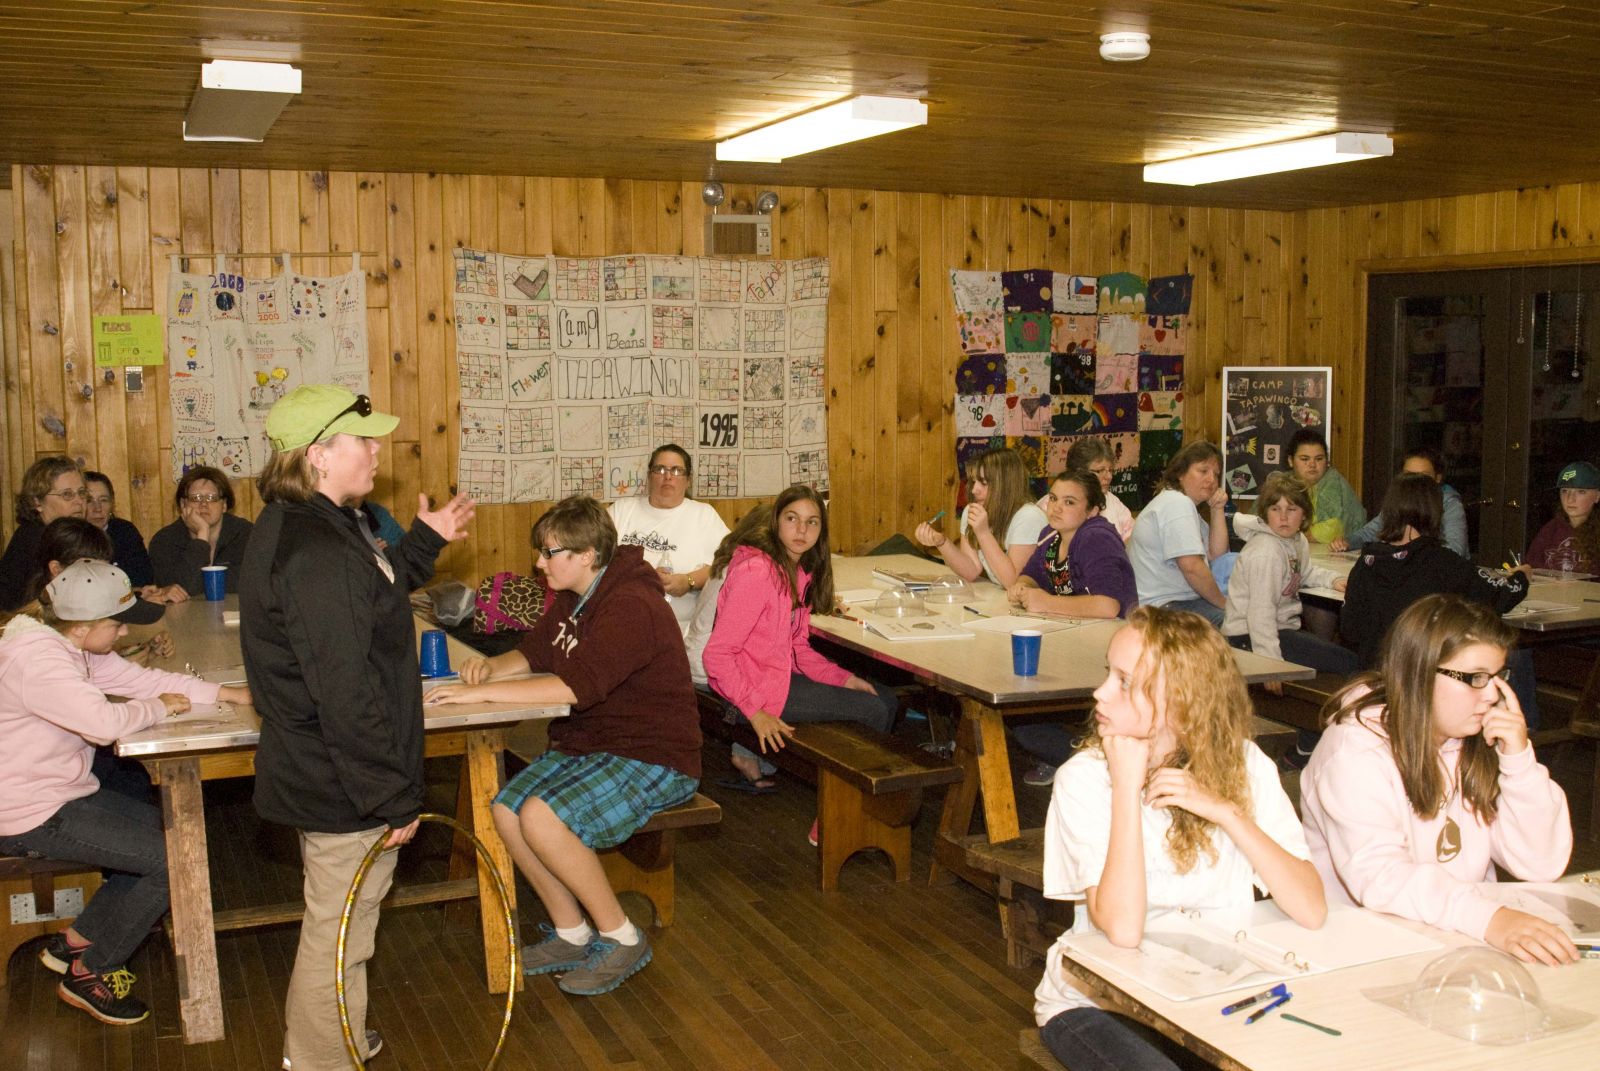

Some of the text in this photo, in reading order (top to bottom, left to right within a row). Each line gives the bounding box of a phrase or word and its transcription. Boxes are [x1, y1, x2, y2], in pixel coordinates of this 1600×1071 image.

[209, 273, 244, 292] 2000
[258, 313, 280, 321] 2000
[607, 333, 644, 349] Beans
[559, 356, 691, 399] TAPAWINGO
[1252, 381, 1283, 389] CAMP
[1240, 395, 1298, 408] TAPAWINGO
[700, 413, 738, 447] 1995
[646, 542, 677, 552] Escape
